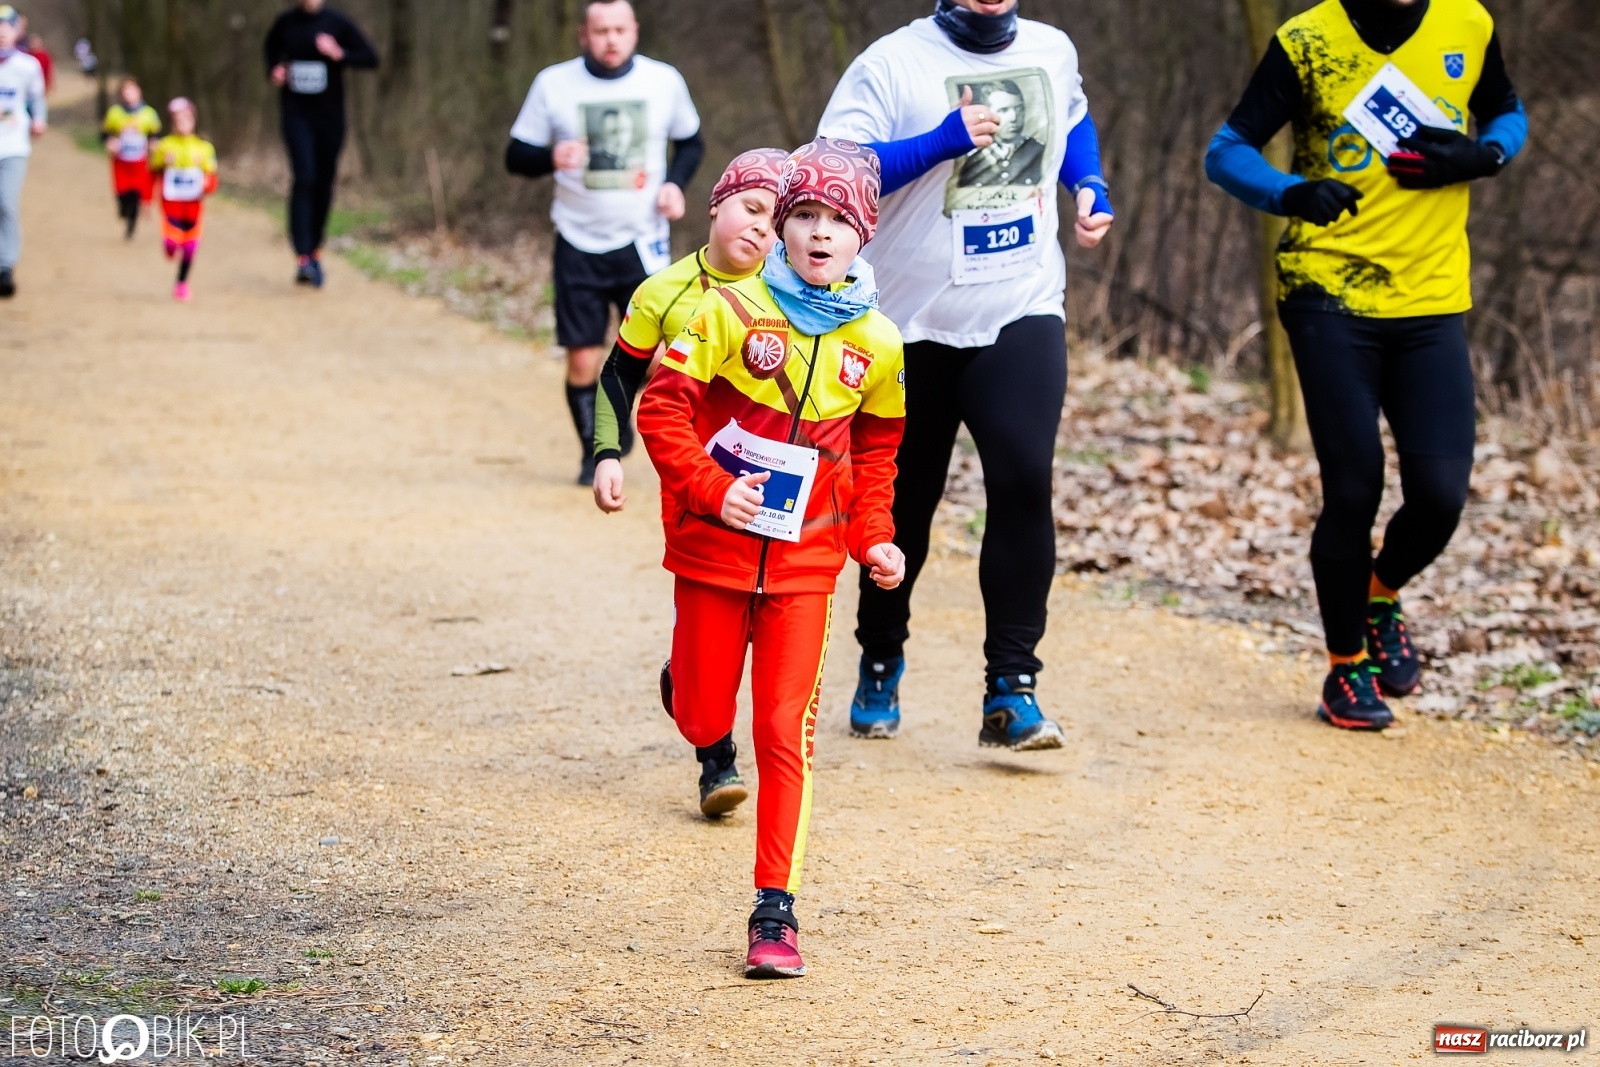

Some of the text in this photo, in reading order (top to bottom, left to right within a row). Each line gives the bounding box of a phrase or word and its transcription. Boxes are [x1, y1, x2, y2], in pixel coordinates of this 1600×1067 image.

[1382, 106, 1417, 139] 193
[987, 226, 1020, 249] 120
[842, 339, 875, 360] POLSKA
